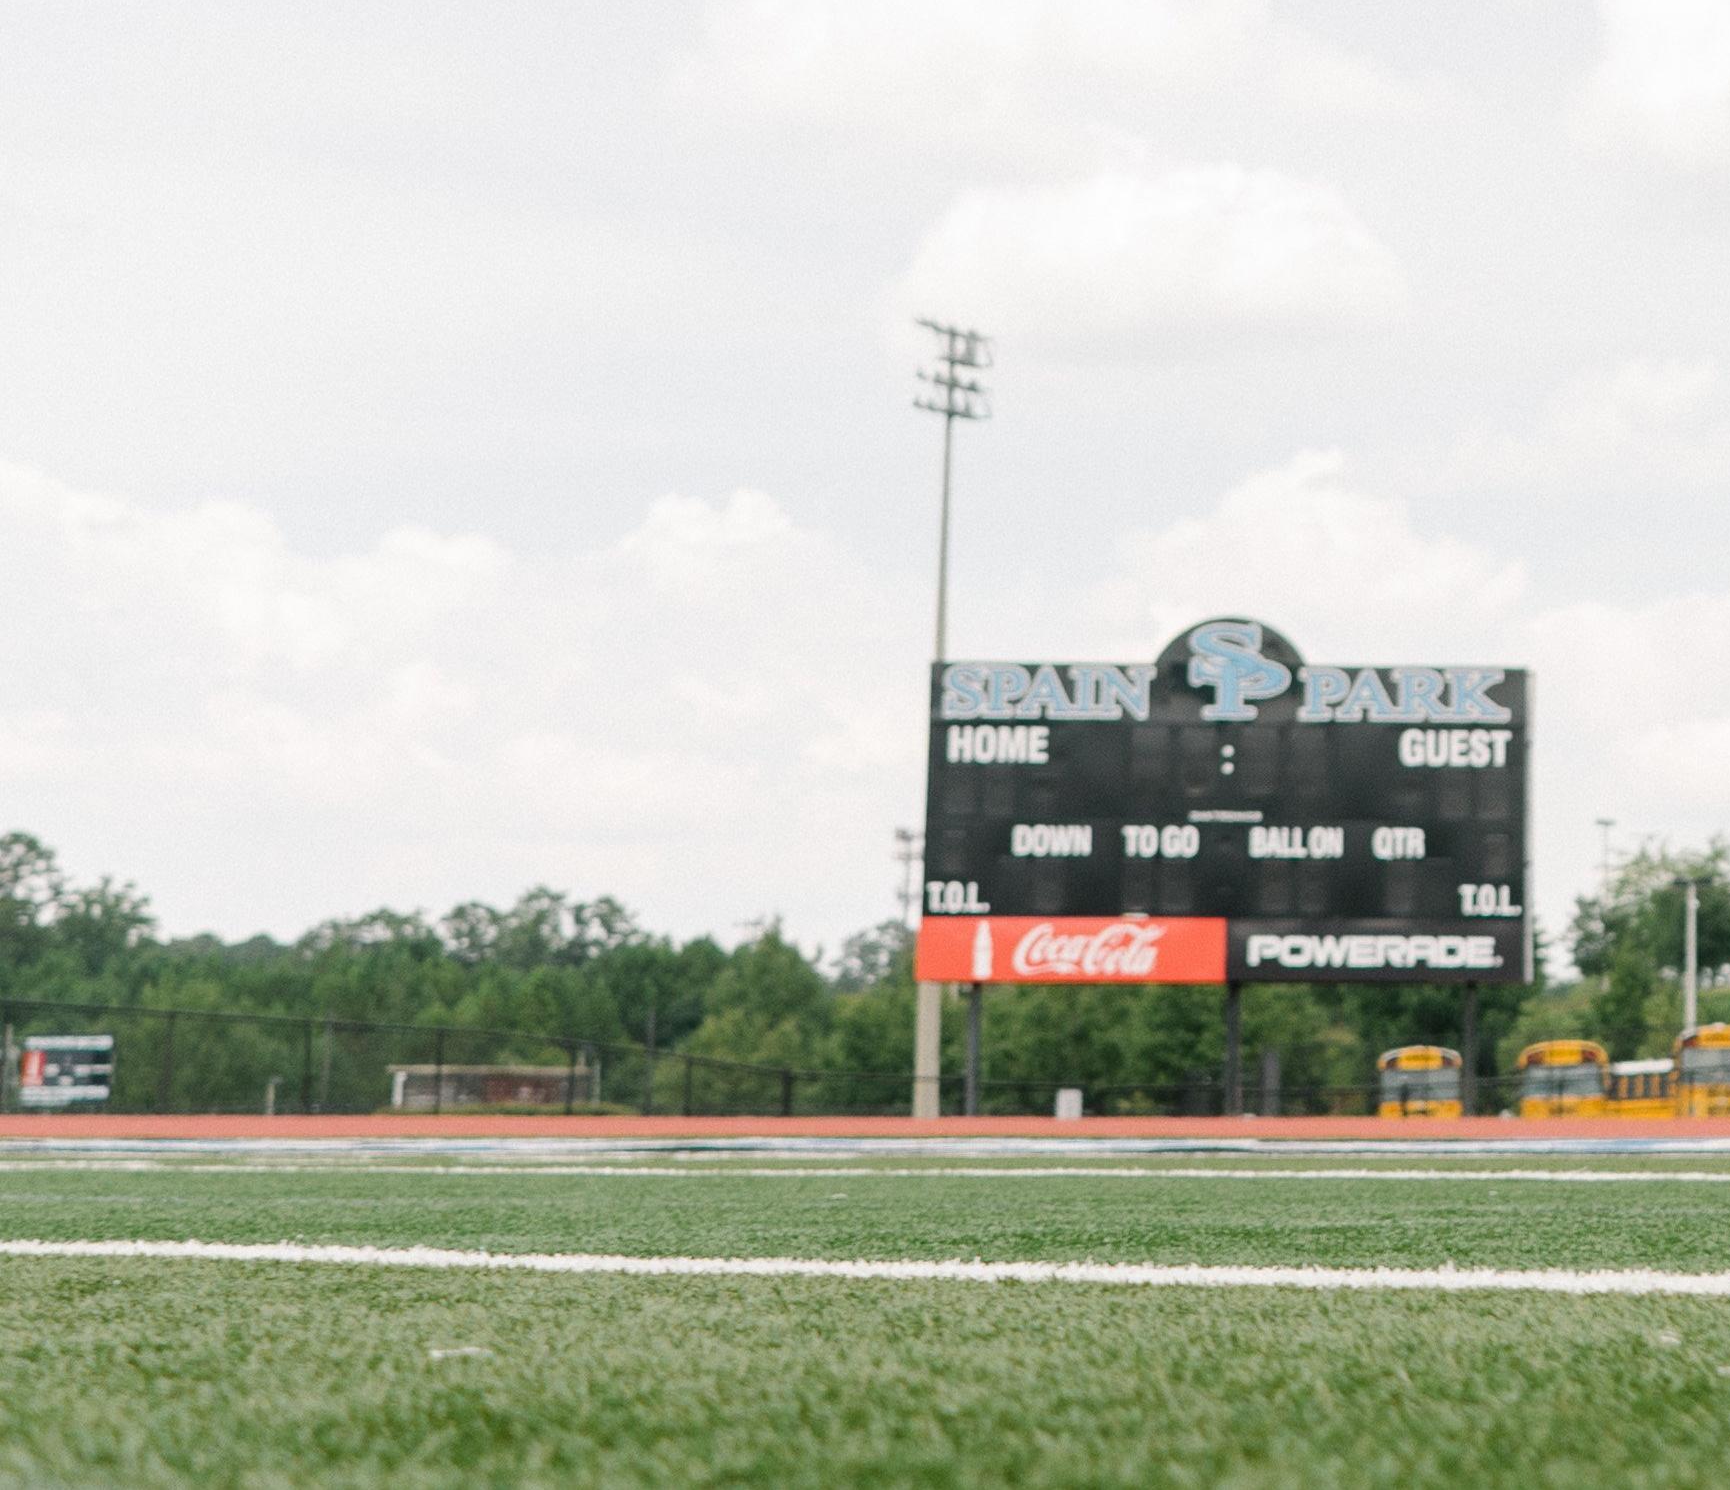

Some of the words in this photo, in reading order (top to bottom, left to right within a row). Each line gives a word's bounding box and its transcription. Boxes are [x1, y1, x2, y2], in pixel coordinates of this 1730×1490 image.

[940, 663, 1157, 720] SPAIN
[1296, 666, 1512, 723] PARK
[946, 725, 1050, 763] HOME
[1398, 728, 1512, 767] GUEST
[1011, 824, 1093, 856] DOWN
[1122, 825, 1159, 858] TO
[1160, 825, 1200, 858] GO
[1248, 826, 1308, 859] BALL
[1307, 826, 1344, 859] ON
[1372, 826, 1426, 860] QTR
[1246, 935, 1497, 968] POWERADE
